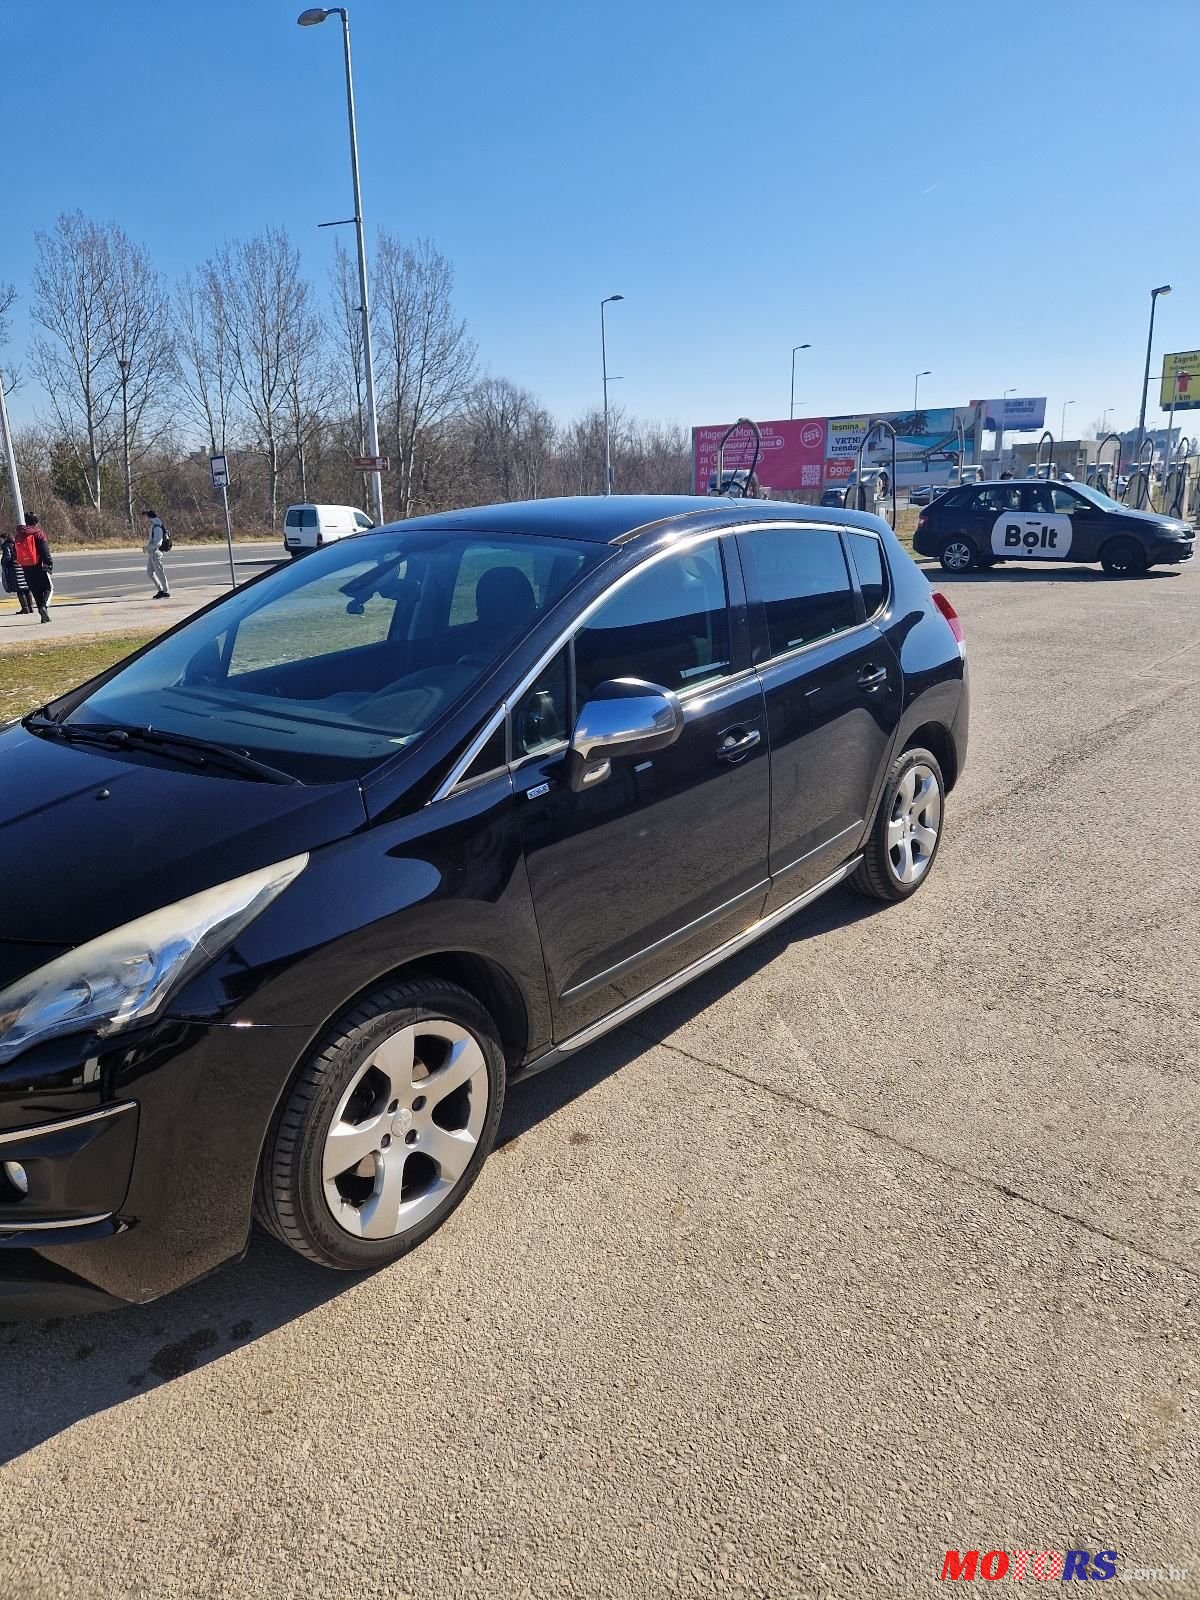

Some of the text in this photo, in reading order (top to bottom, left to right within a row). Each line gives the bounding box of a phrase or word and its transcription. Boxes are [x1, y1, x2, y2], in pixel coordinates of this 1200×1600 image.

[1173, 355, 1198, 364] Zagreb
[700, 426, 773, 442] Magena Momnts
[753, 438, 775, 448] lence
[835, 436, 861, 445] VRTNI
[831, 444, 861, 452] trendo
[700, 456, 708, 464] za
[1004, 524, 1058, 549] Bolt
